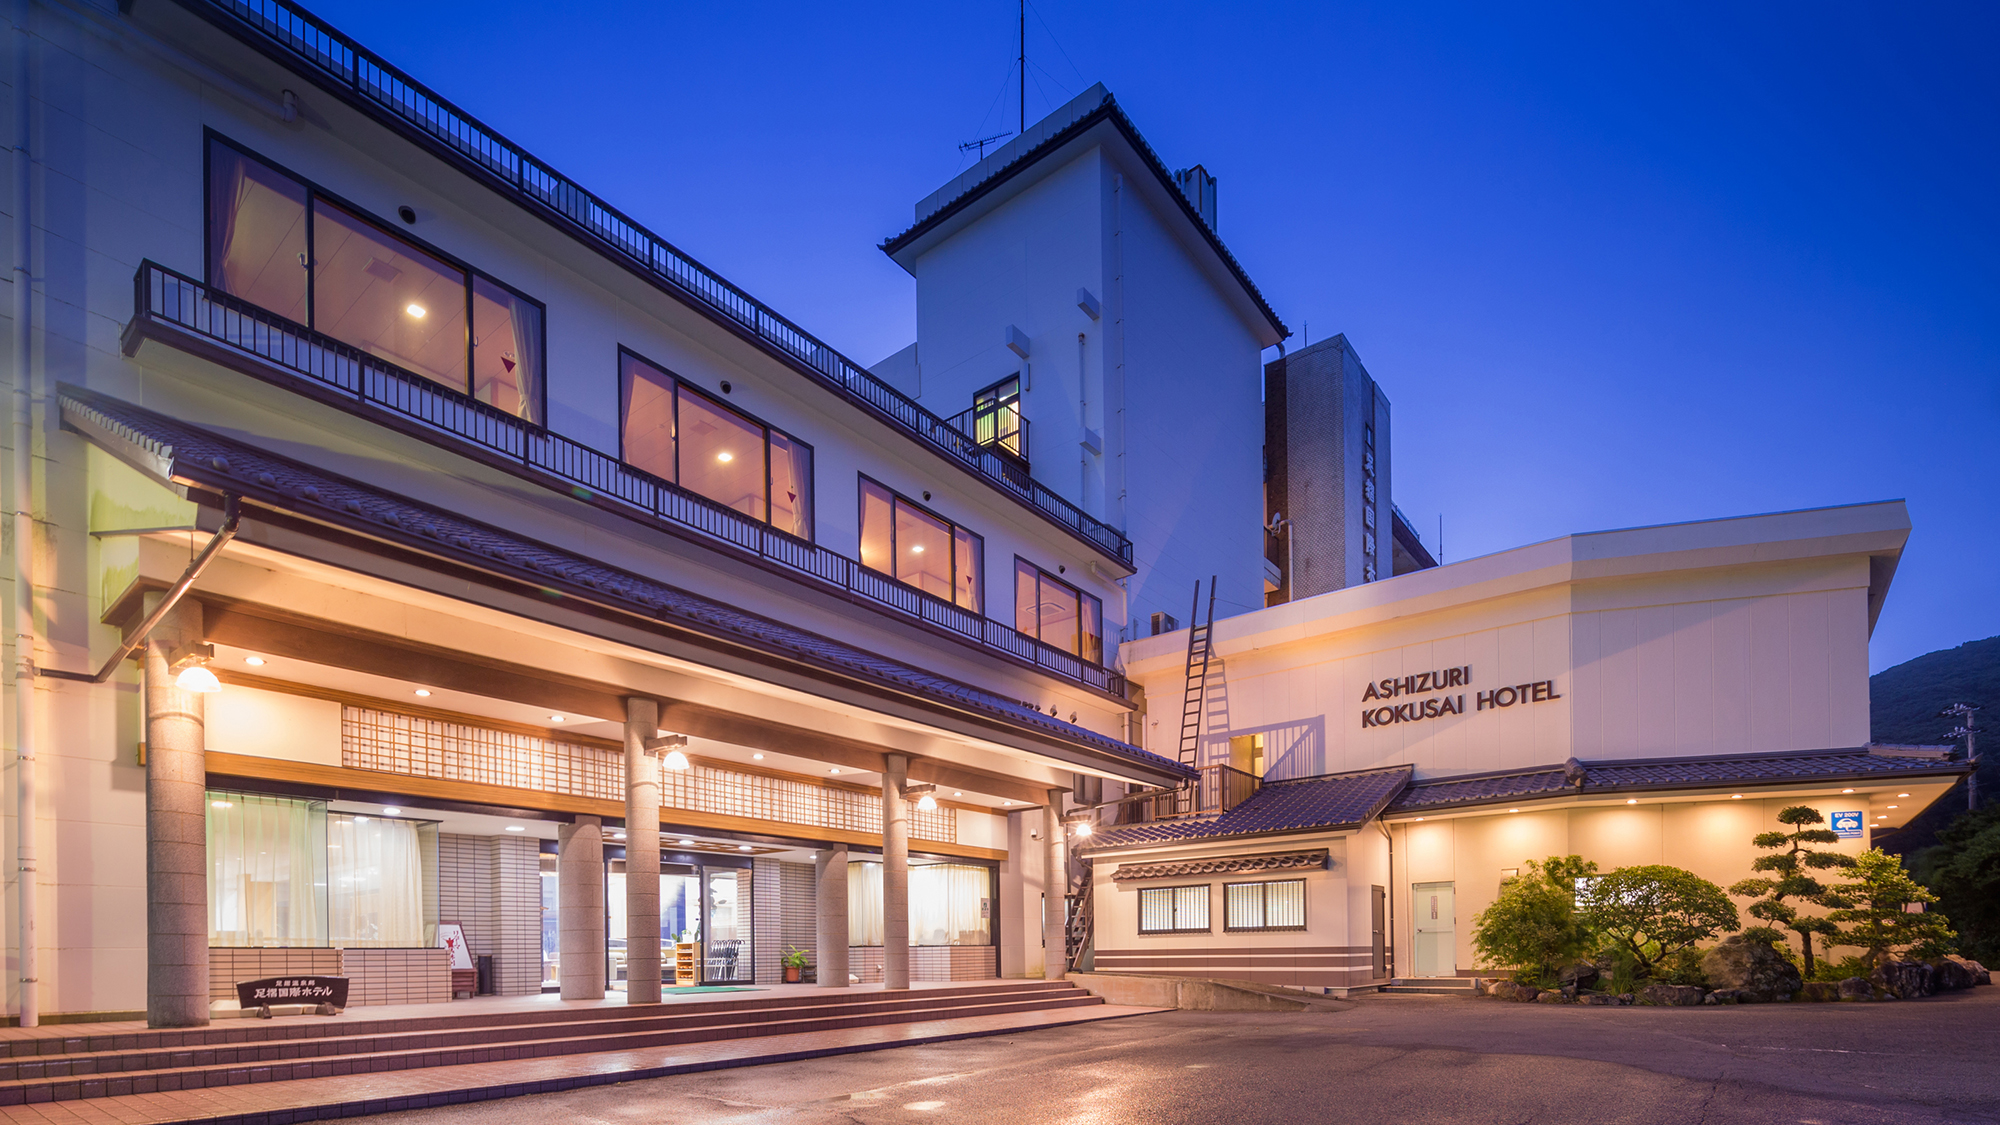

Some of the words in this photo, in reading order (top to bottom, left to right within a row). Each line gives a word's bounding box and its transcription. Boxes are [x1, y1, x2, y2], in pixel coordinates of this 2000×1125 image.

[1362, 666, 1468, 702] ASHIZURI
[1362, 695, 1463, 728] KOKUSAI
[1477, 680, 1560, 711] HOTEL
[254, 986, 333, 999] 足摺国際ホテル
